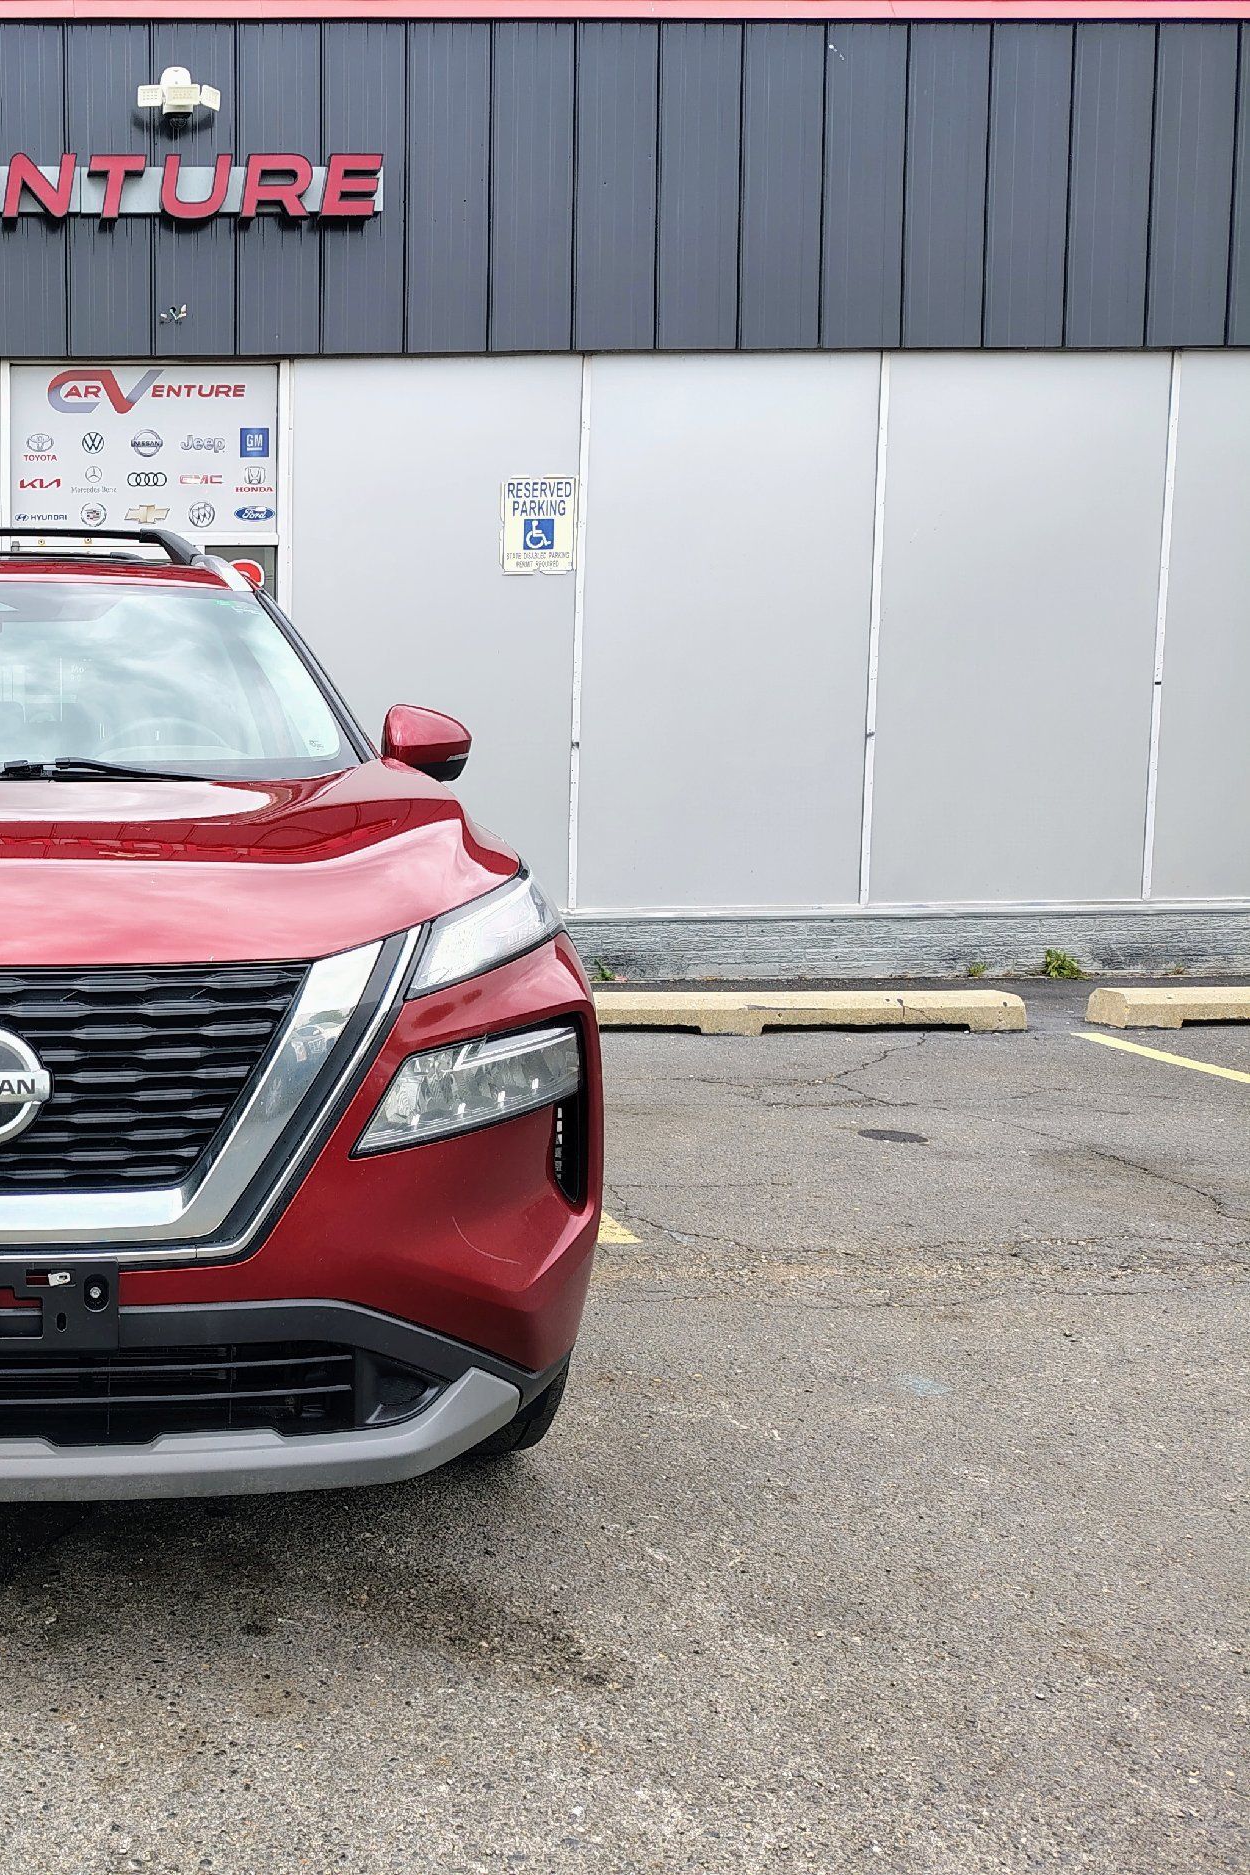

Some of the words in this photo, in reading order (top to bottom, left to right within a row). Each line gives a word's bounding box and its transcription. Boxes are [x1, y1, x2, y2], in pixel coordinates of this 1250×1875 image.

[180, 434, 226, 453] Jeep
[246, 434, 263, 447] GM
[19, 478, 62, 489] KIA
[507, 482, 572, 498] RESERVED
[240, 506, 267, 519] Ford
[512, 499, 566, 517] PARKING
